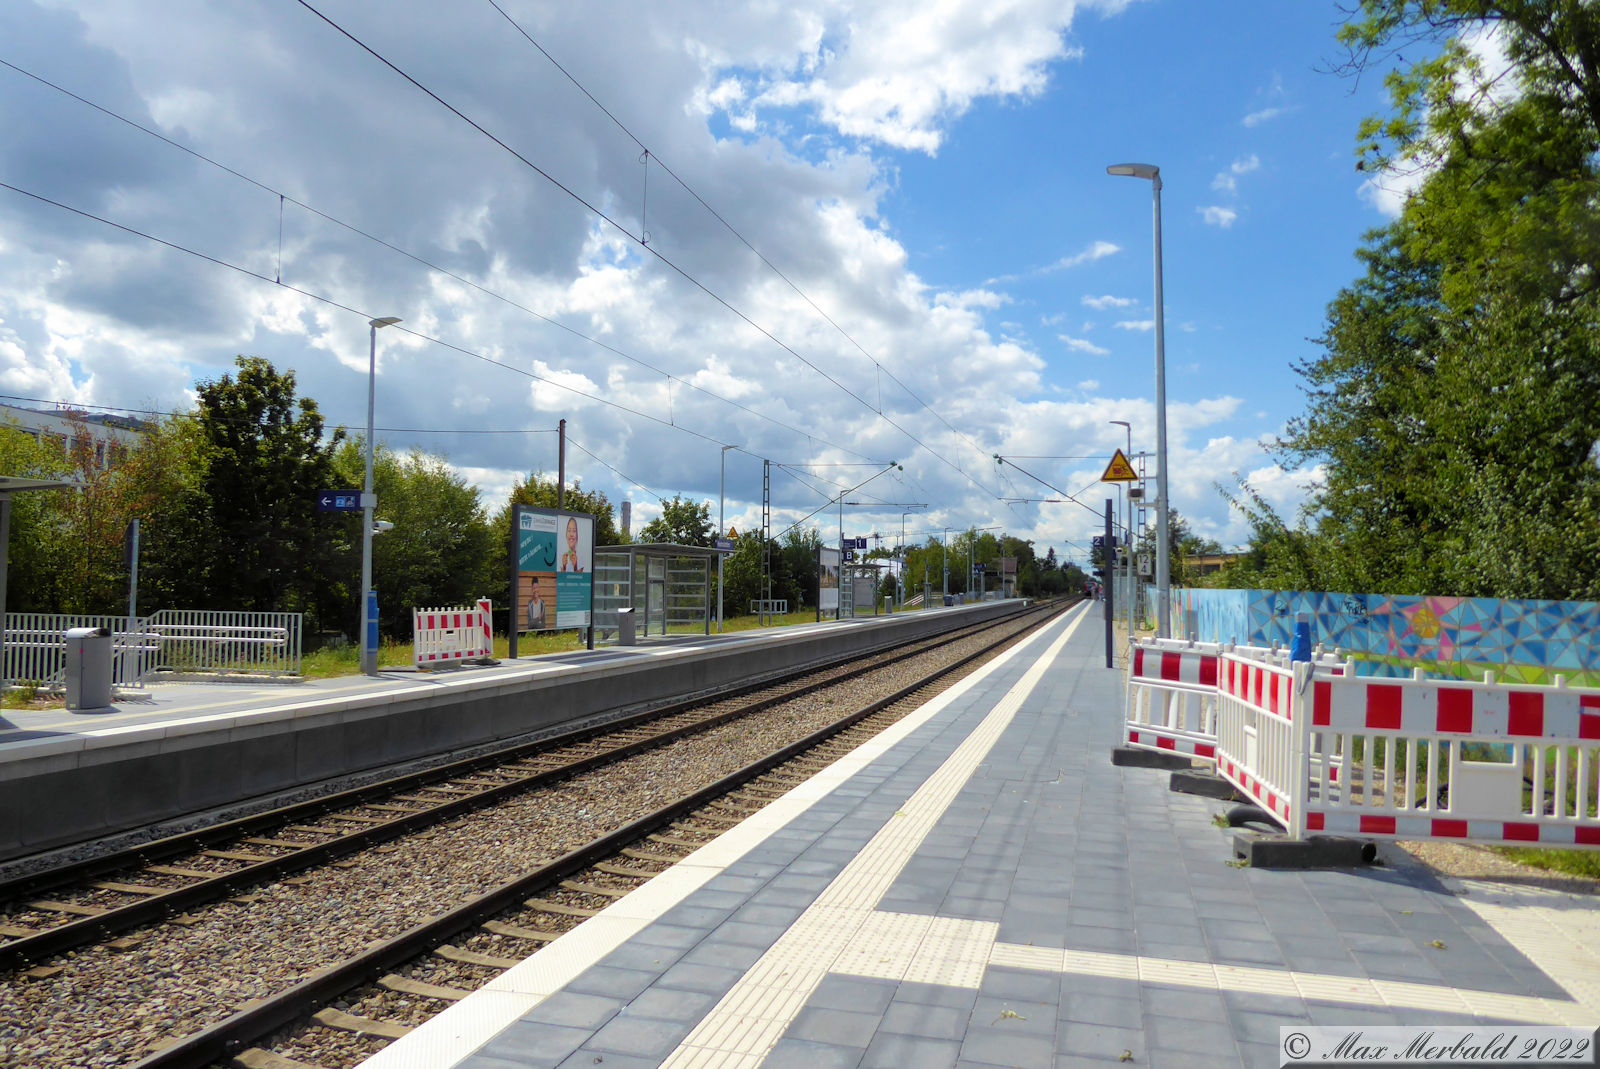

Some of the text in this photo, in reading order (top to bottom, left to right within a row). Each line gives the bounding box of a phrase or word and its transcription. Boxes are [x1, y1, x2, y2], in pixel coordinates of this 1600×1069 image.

[1094, 537, 1100, 546] 2
[846, 551, 852, 560] B
[1139, 554, 1149, 563] 12
[1140, 564, 1147, 573] 4
